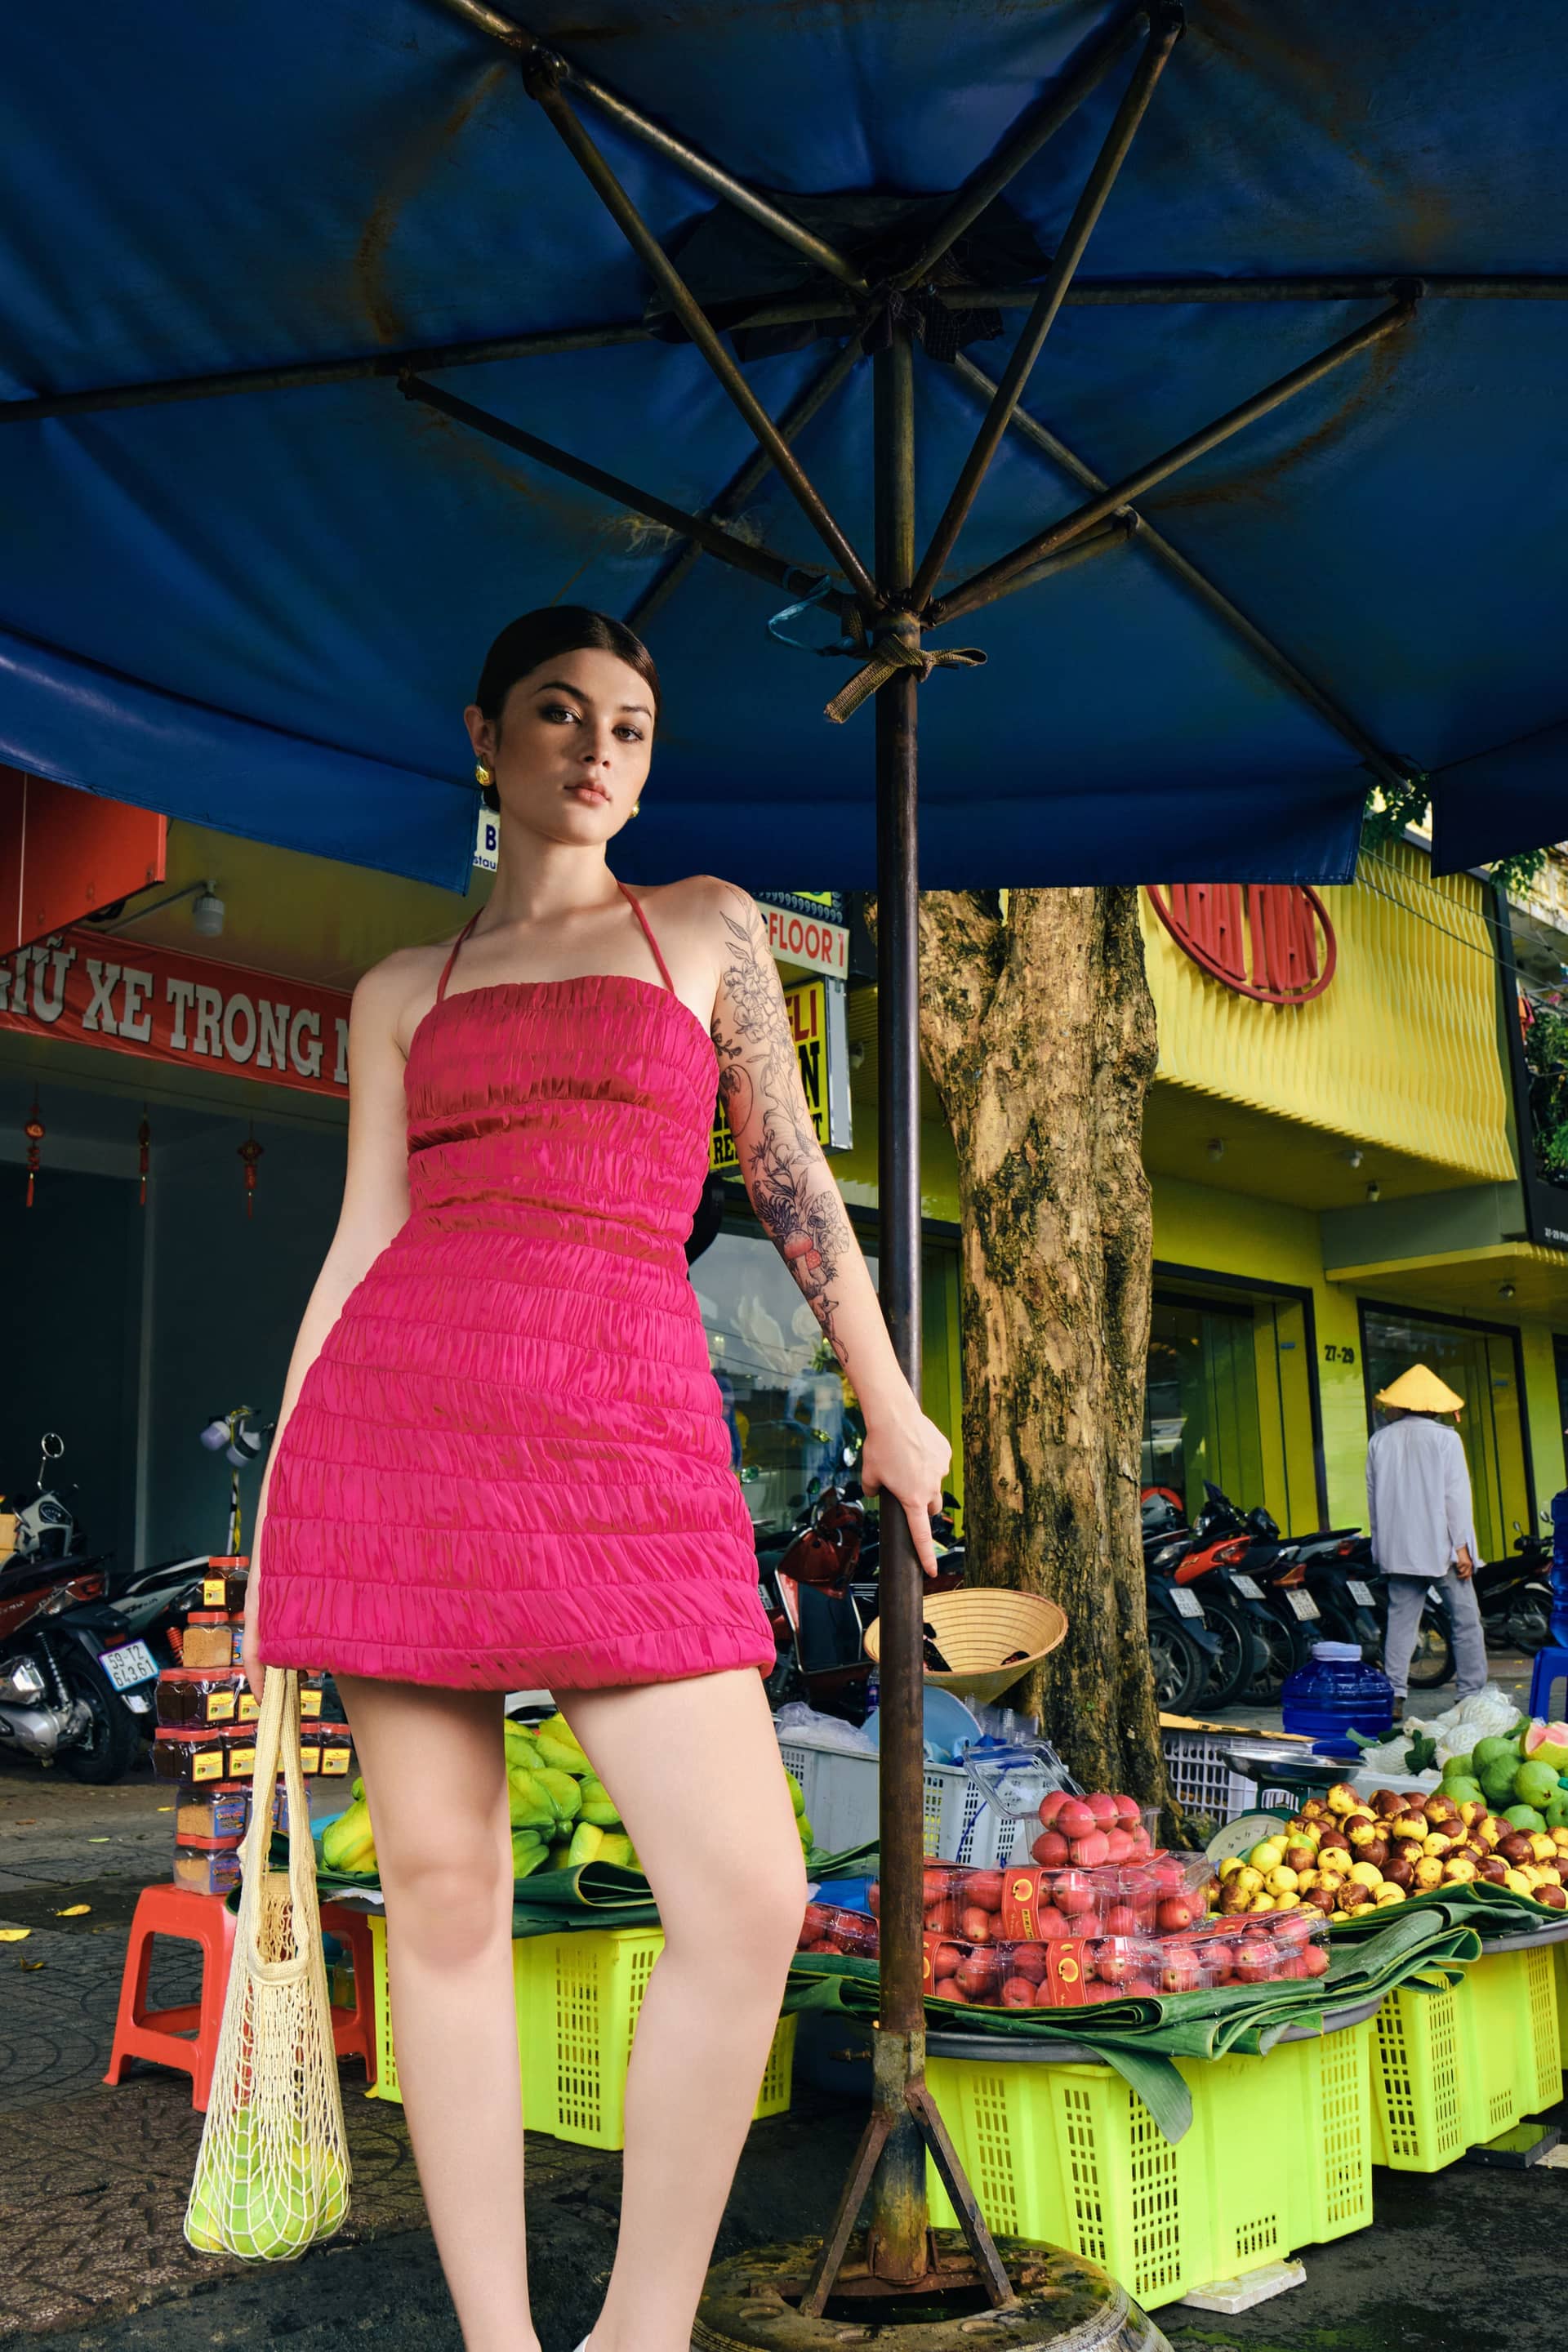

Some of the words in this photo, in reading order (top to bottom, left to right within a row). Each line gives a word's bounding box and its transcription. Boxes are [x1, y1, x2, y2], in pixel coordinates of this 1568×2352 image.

[769, 911, 833, 964] FLOOR
[837, 932, 844, 968] 1
[82, 958, 154, 1043] XE
[167, 978, 323, 1078] TRONG
[1325, 1344, 1355, 1364] 27-29
[108, 1645, 145, 1670] 59-T2
